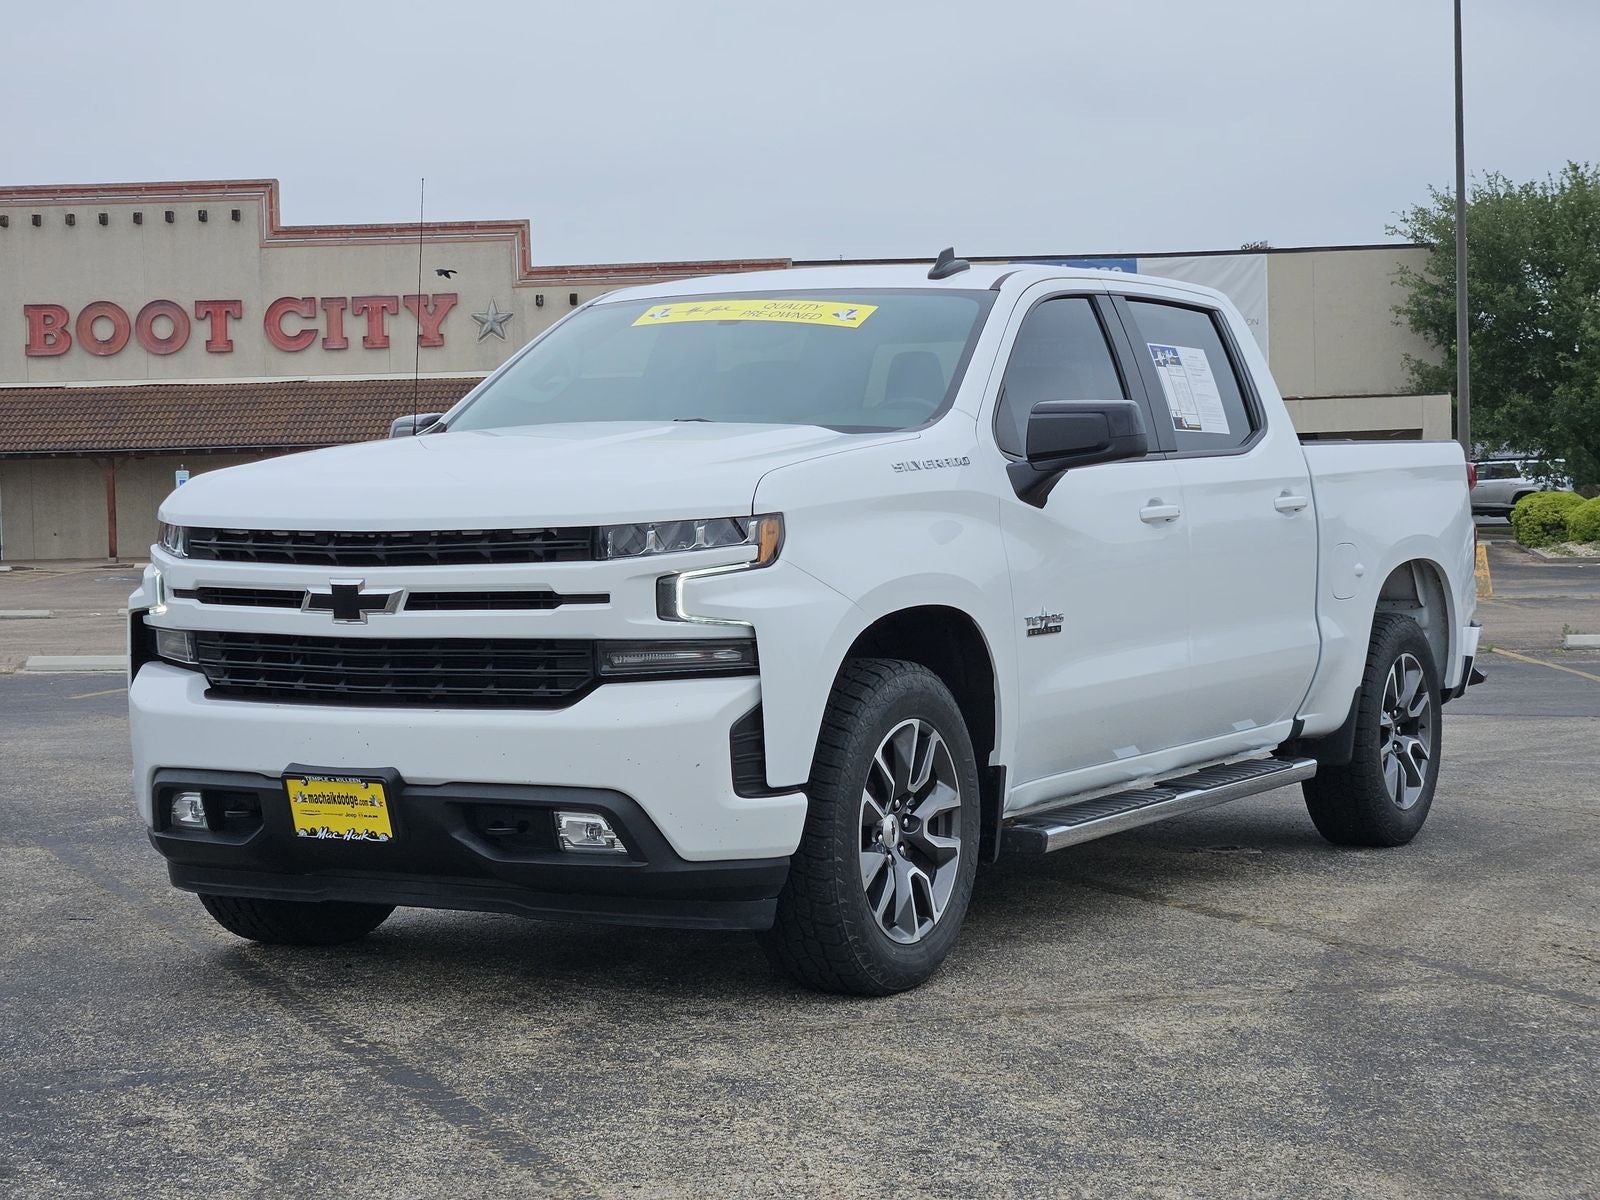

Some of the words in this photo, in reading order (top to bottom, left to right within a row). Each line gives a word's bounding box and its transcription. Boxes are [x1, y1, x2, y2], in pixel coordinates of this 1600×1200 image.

[764, 302, 824, 311] QUALITY
[740, 310, 823, 320] PRE-OWNED
[24, 300, 243, 356] BOOT
[264, 293, 458, 352] CITY
[307, 792, 368, 808] machaikdodge.com
[317, 826, 338, 840] Mac
[343, 828, 369, 840] Haik
